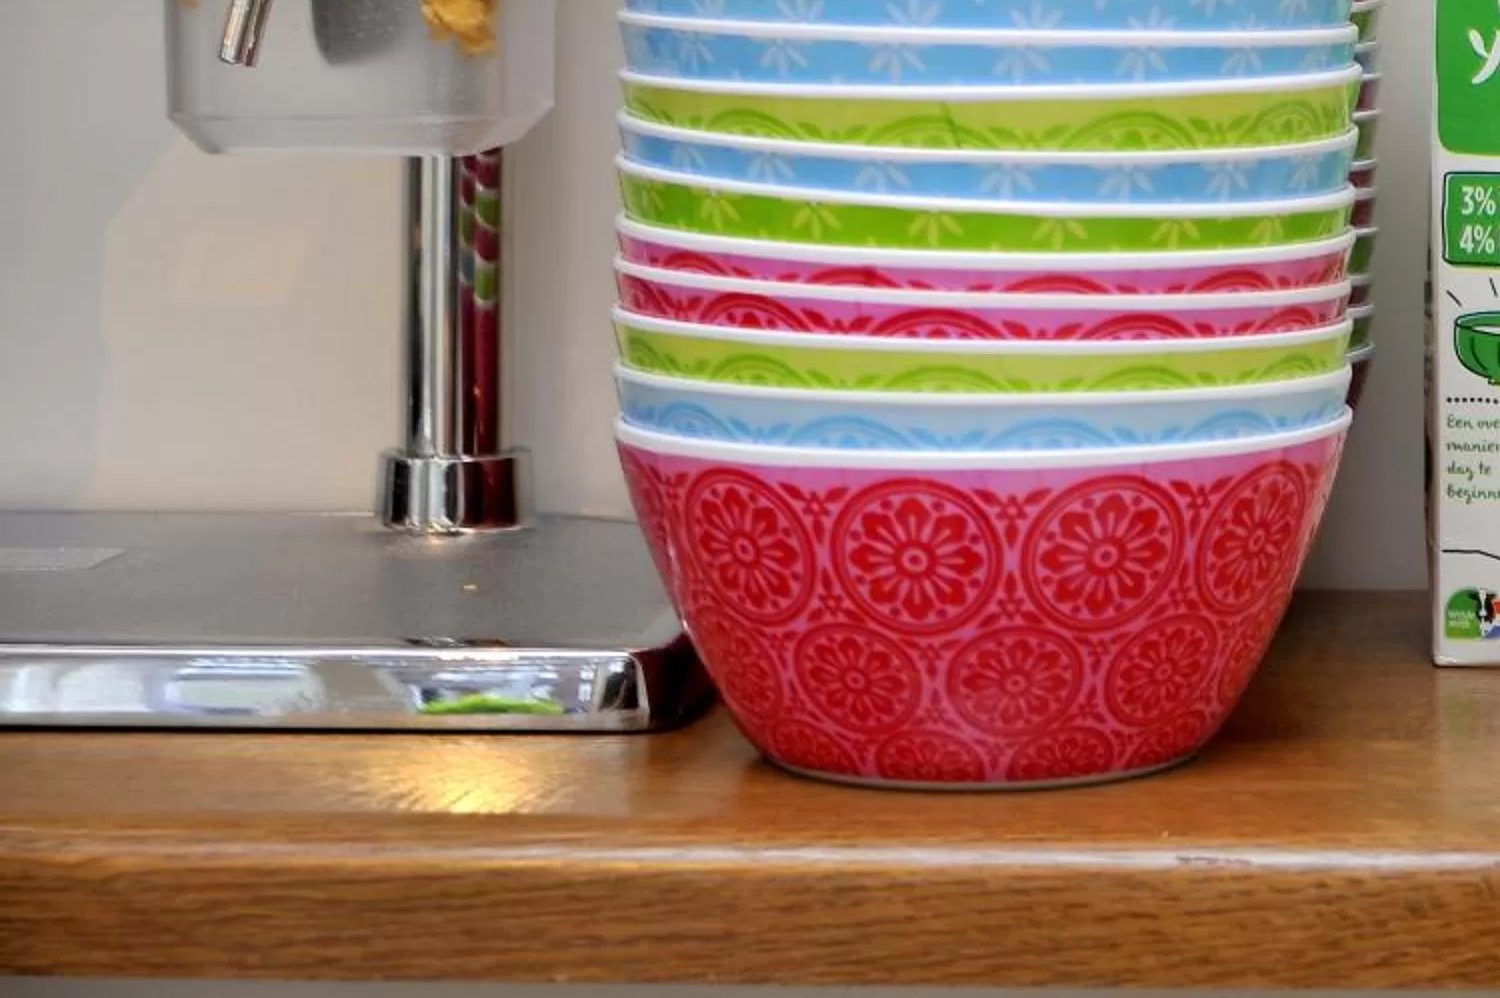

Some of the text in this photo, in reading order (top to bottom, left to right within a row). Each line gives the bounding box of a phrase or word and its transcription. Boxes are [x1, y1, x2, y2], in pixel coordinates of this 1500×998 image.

[1460, 185, 1496, 216] 3%
[1459, 226, 1495, 254] 4%
[1447, 413, 1473, 429] Een
[1447, 459, 1474, 481] dag
